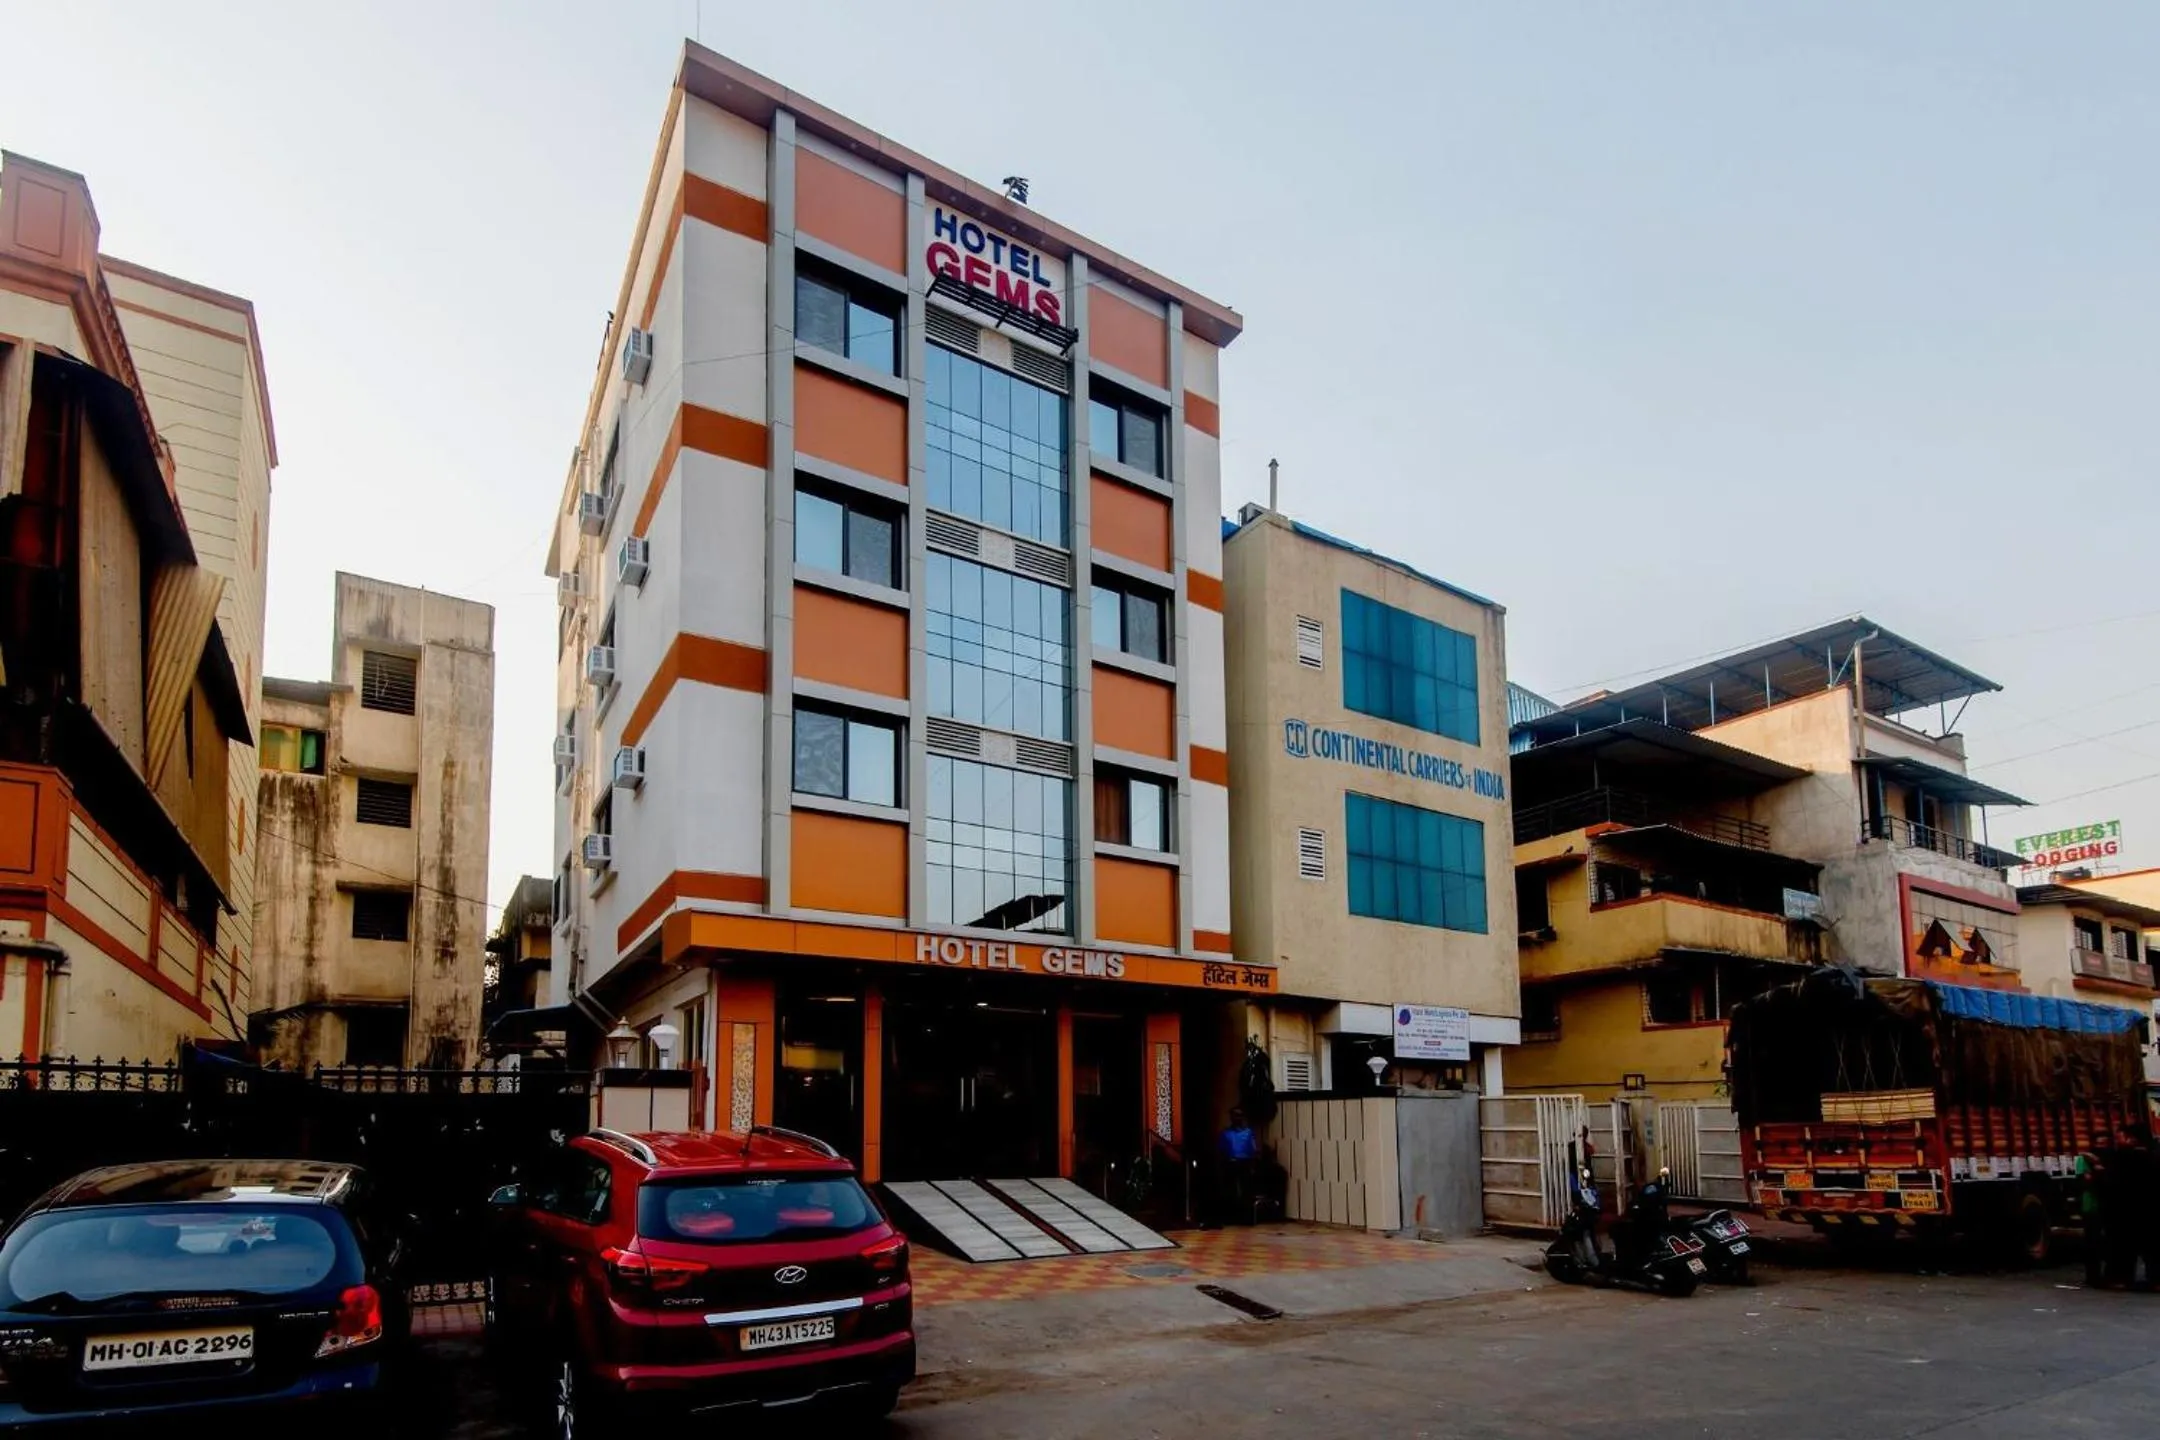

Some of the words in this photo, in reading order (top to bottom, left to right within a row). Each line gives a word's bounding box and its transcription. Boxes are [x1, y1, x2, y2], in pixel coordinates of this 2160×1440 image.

[934, 207, 1051, 288] HOTEL
[926, 241, 1061, 326] GEMS
[1312, 727, 1407, 776] CONTINENTAL
[1408, 751, 1465, 789] CARRIERS
[1474, 767, 1505, 801] INDIA
[2015, 820, 2119, 853] EVEREST
[916, 934, 1026, 970] HOTEL
[1042, 946, 1125, 977] GEMS
[749, 1319, 834, 1346] MH43AT5225
